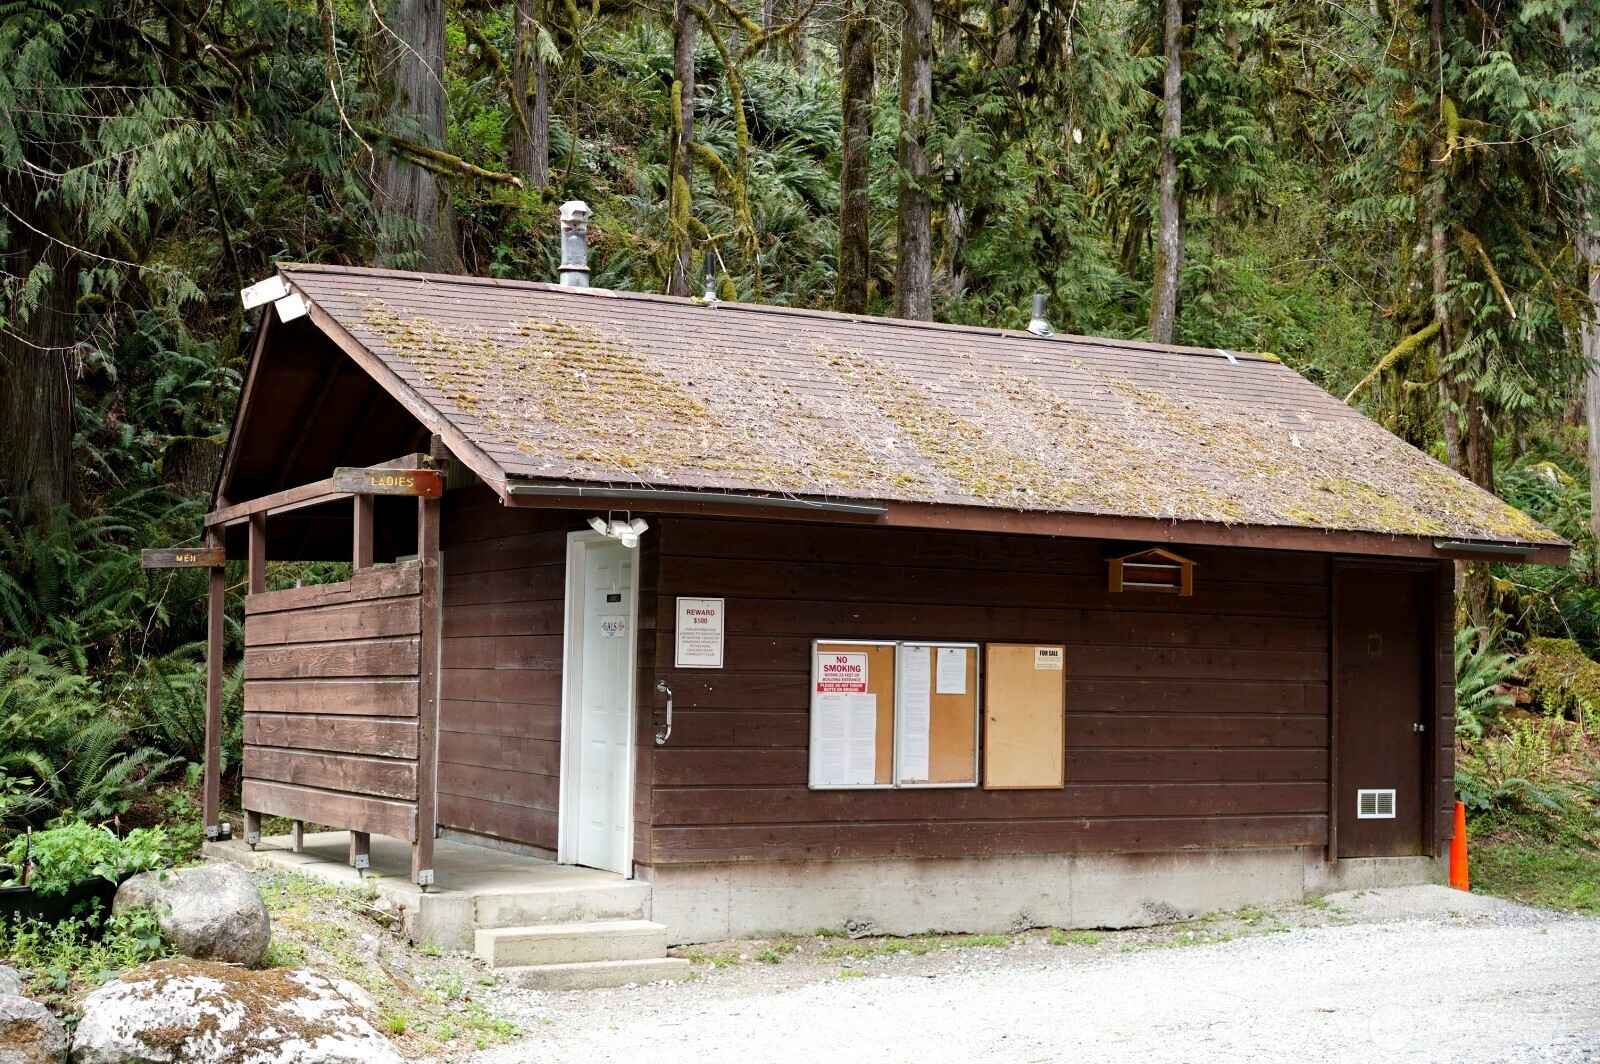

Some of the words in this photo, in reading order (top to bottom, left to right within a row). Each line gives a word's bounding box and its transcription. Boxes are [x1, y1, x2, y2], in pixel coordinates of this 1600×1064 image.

[371, 475, 414, 487] LADIES
[175, 554, 196, 562] MEN
[836, 656, 848, 664] NO
